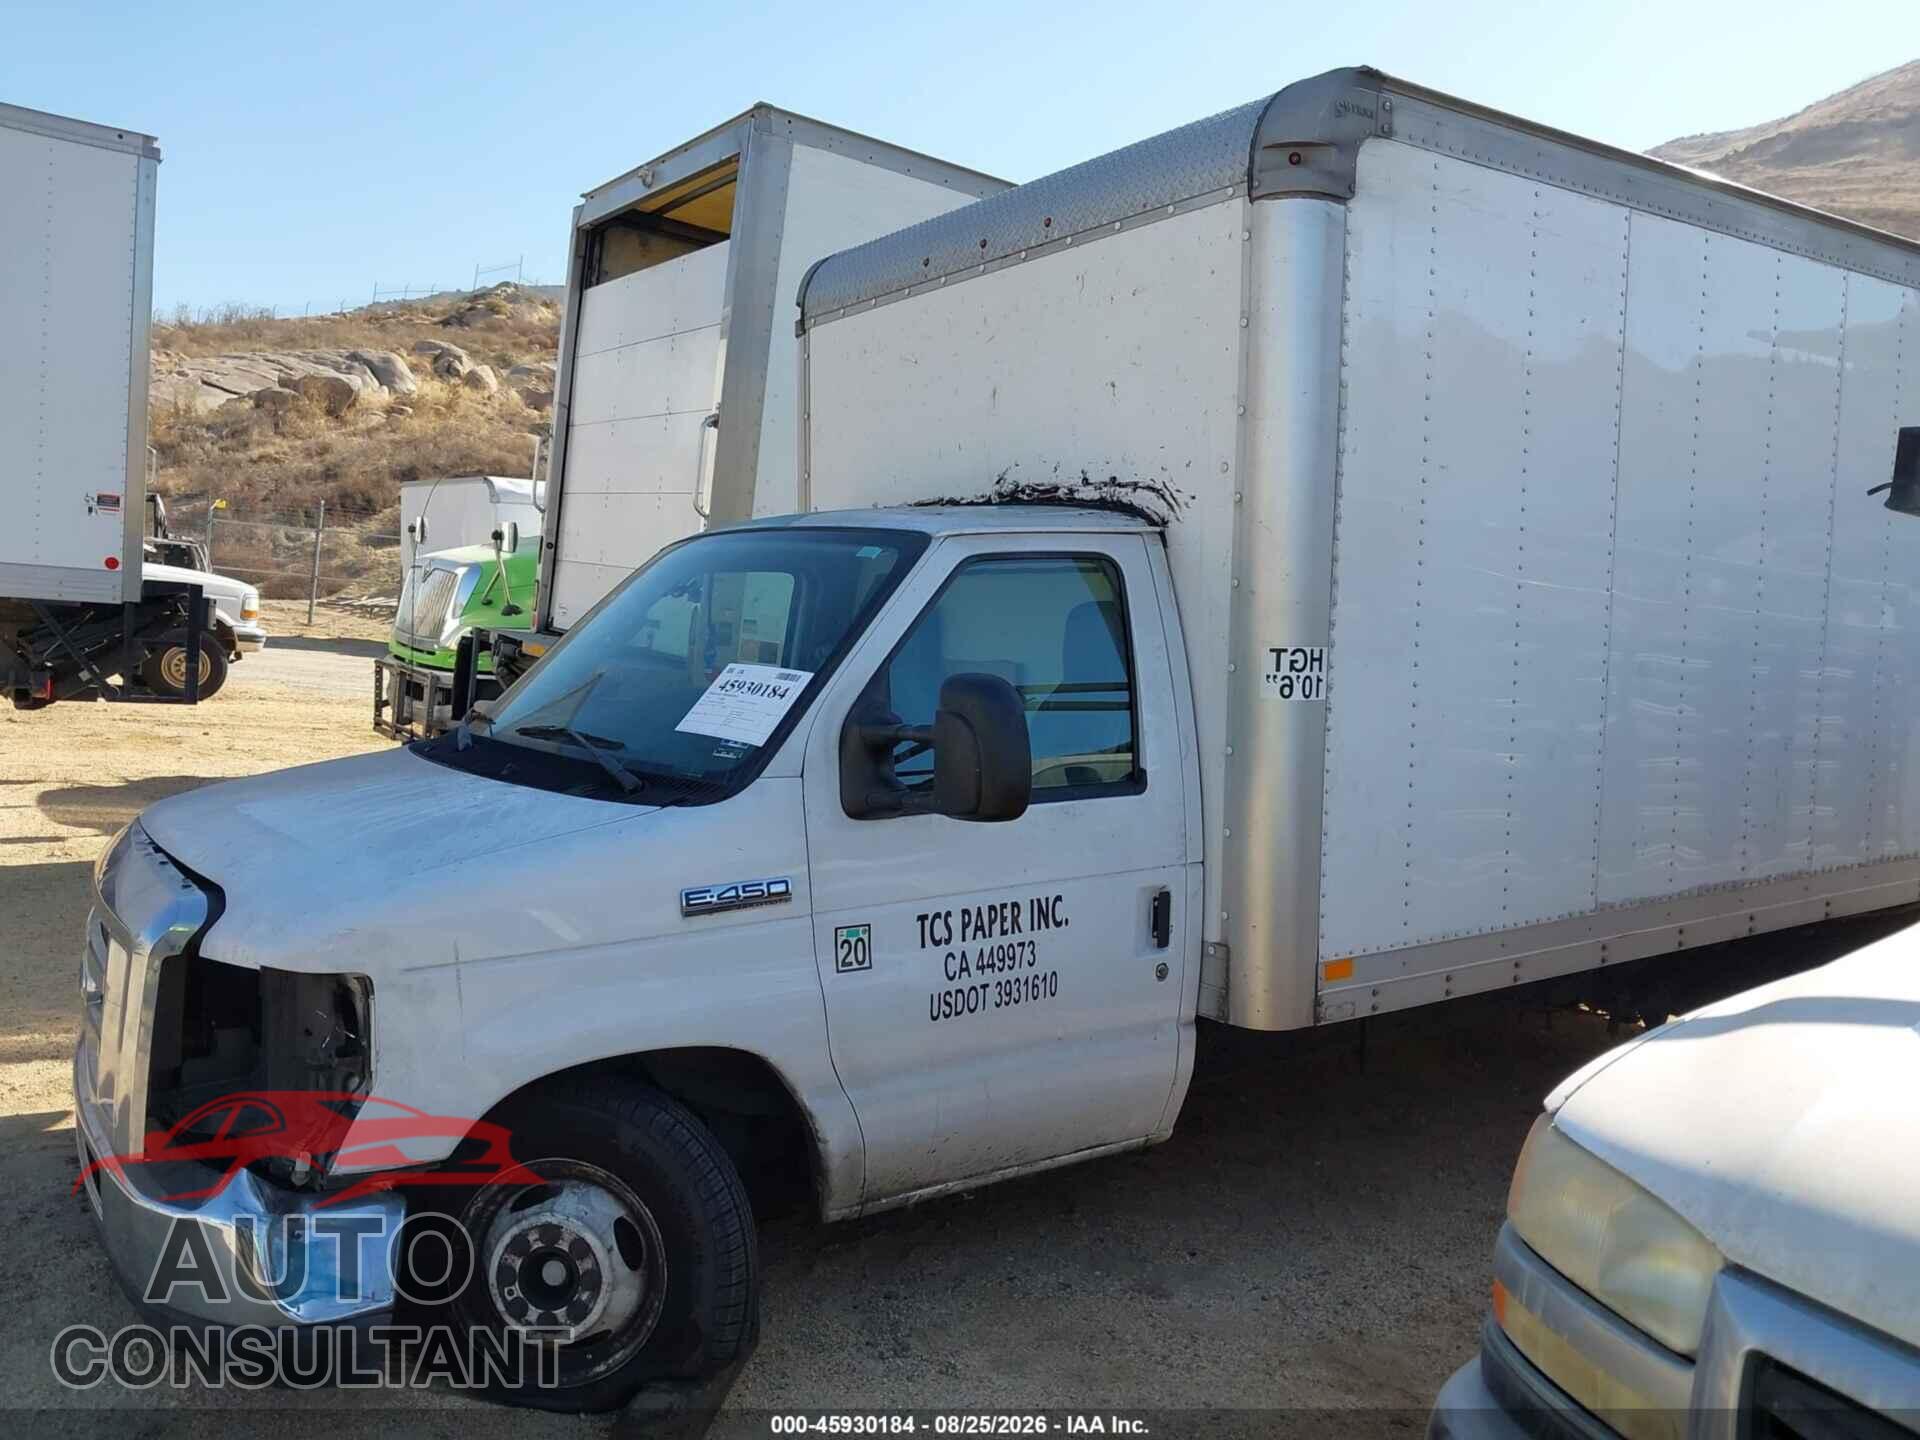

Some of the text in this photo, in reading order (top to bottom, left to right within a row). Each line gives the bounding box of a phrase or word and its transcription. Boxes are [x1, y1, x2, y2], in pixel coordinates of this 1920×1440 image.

[718, 679, 790, 701] 45930184
[916, 894, 1069, 949] TCS PAPER INC.
[840, 937, 867, 967] 20
[944, 940, 1036, 981] CA 449973
[930, 971, 1058, 1021] USDOT 3931610
